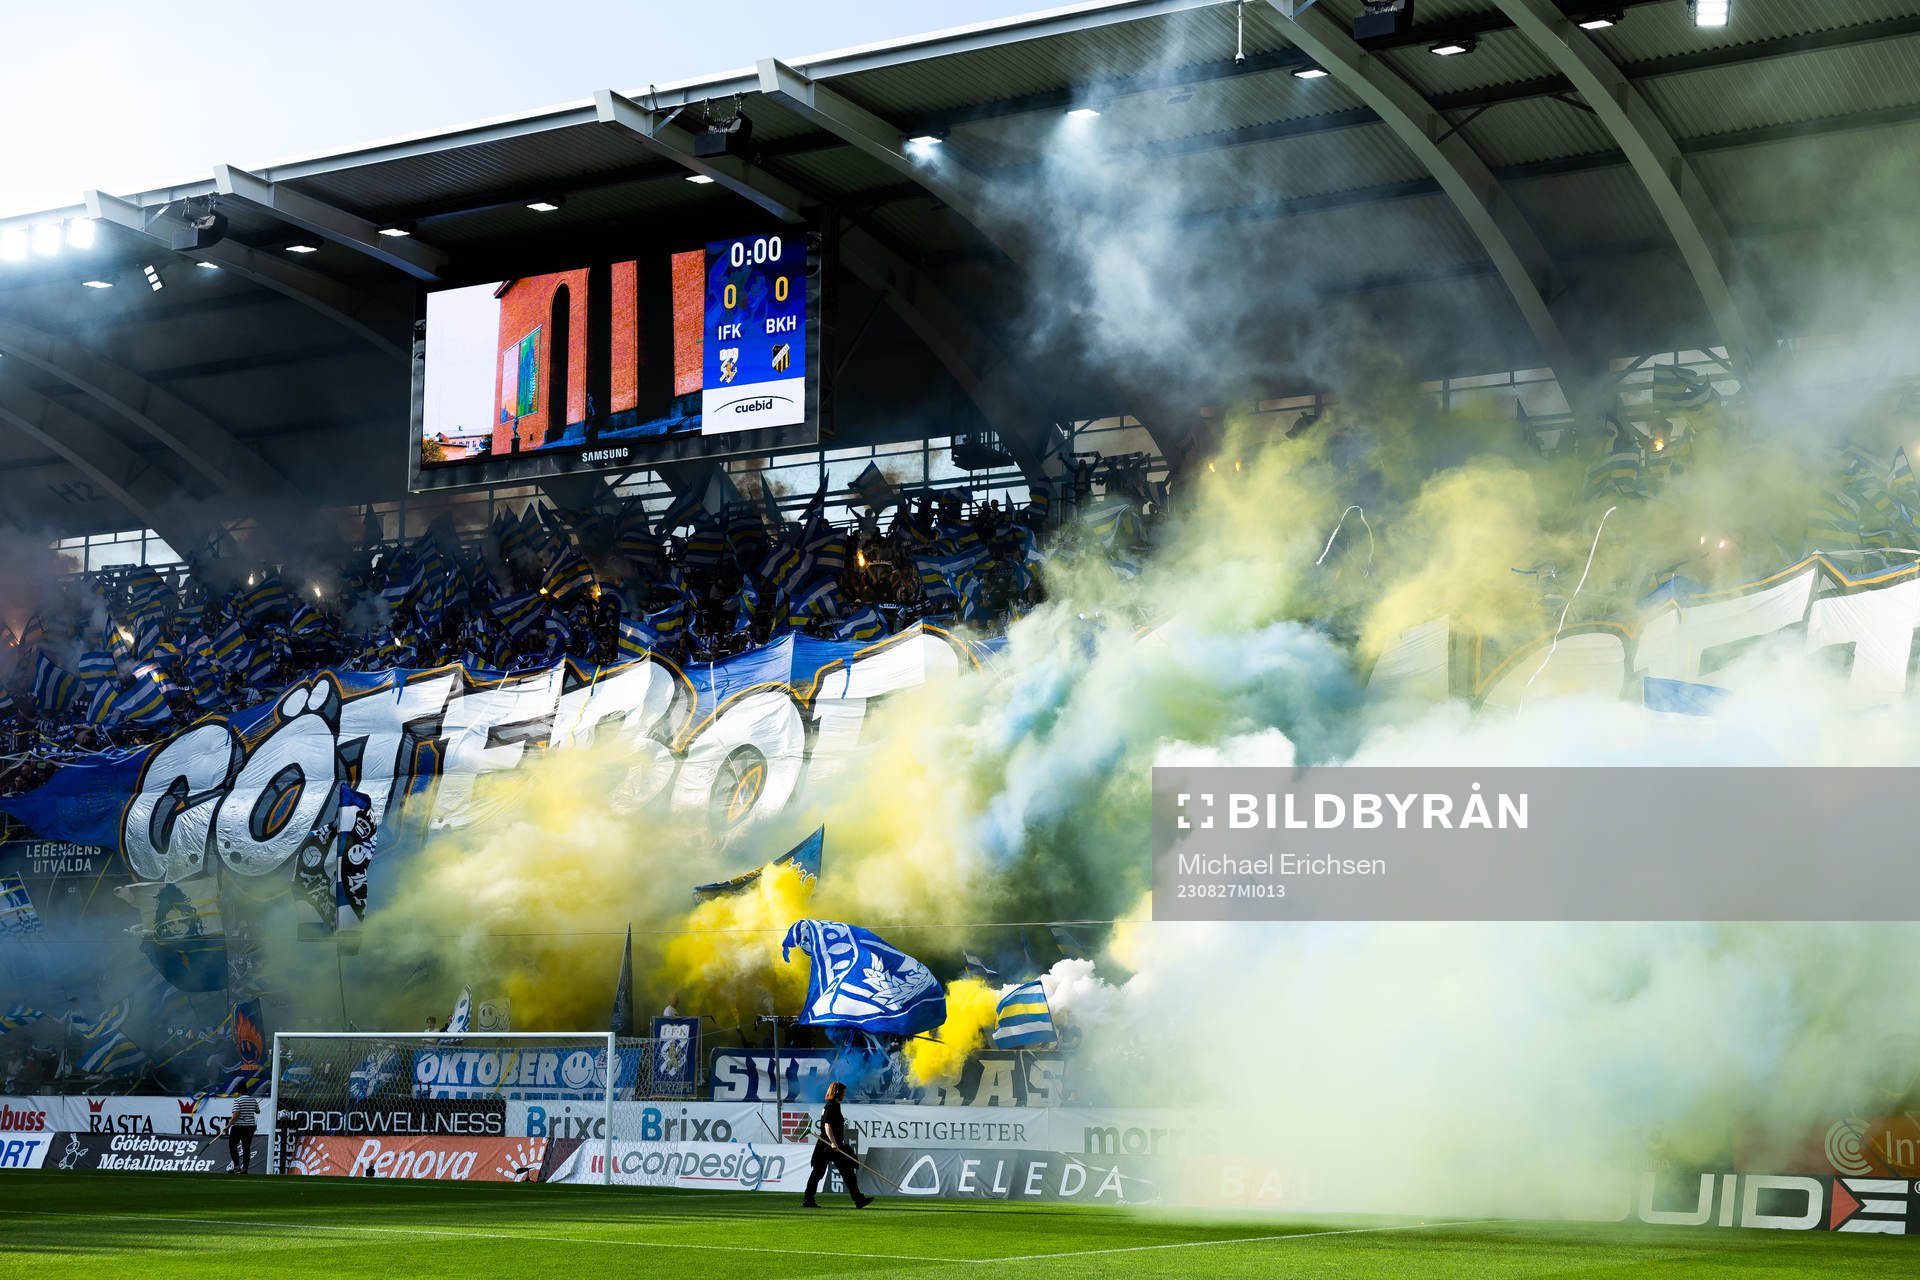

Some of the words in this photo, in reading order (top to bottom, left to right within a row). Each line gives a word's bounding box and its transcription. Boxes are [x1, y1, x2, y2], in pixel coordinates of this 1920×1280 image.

[730, 235, 783, 268] 0:00
[723, 283, 738, 309] 0
[774, 275, 789, 302] 0
[717, 322, 742, 341] IFK
[765, 315, 797, 334] BKH
[735, 398, 773, 414] cuebid
[581, 447, 629, 463] SAMSUNG
[26, 843, 102, 858] LEGENDENS
[33, 859, 93, 874] UTVALDA
[416, 1051, 561, 1086] OKTOBER
[0, 1103, 46, 1132] buss
[89, 1114, 154, 1135] RASTA
[181, 1115, 231, 1136] RAST
[815, 1118, 1027, 1143] SNFASTIGHETER
[110, 1134, 198, 1156] Göteborgs
[1886, 1129, 1920, 1166] In
[97, 1154, 216, 1172] Metallpartier
[350, 1139, 479, 1181] Renova
[957, 1158, 1124, 1199] ELEDA
